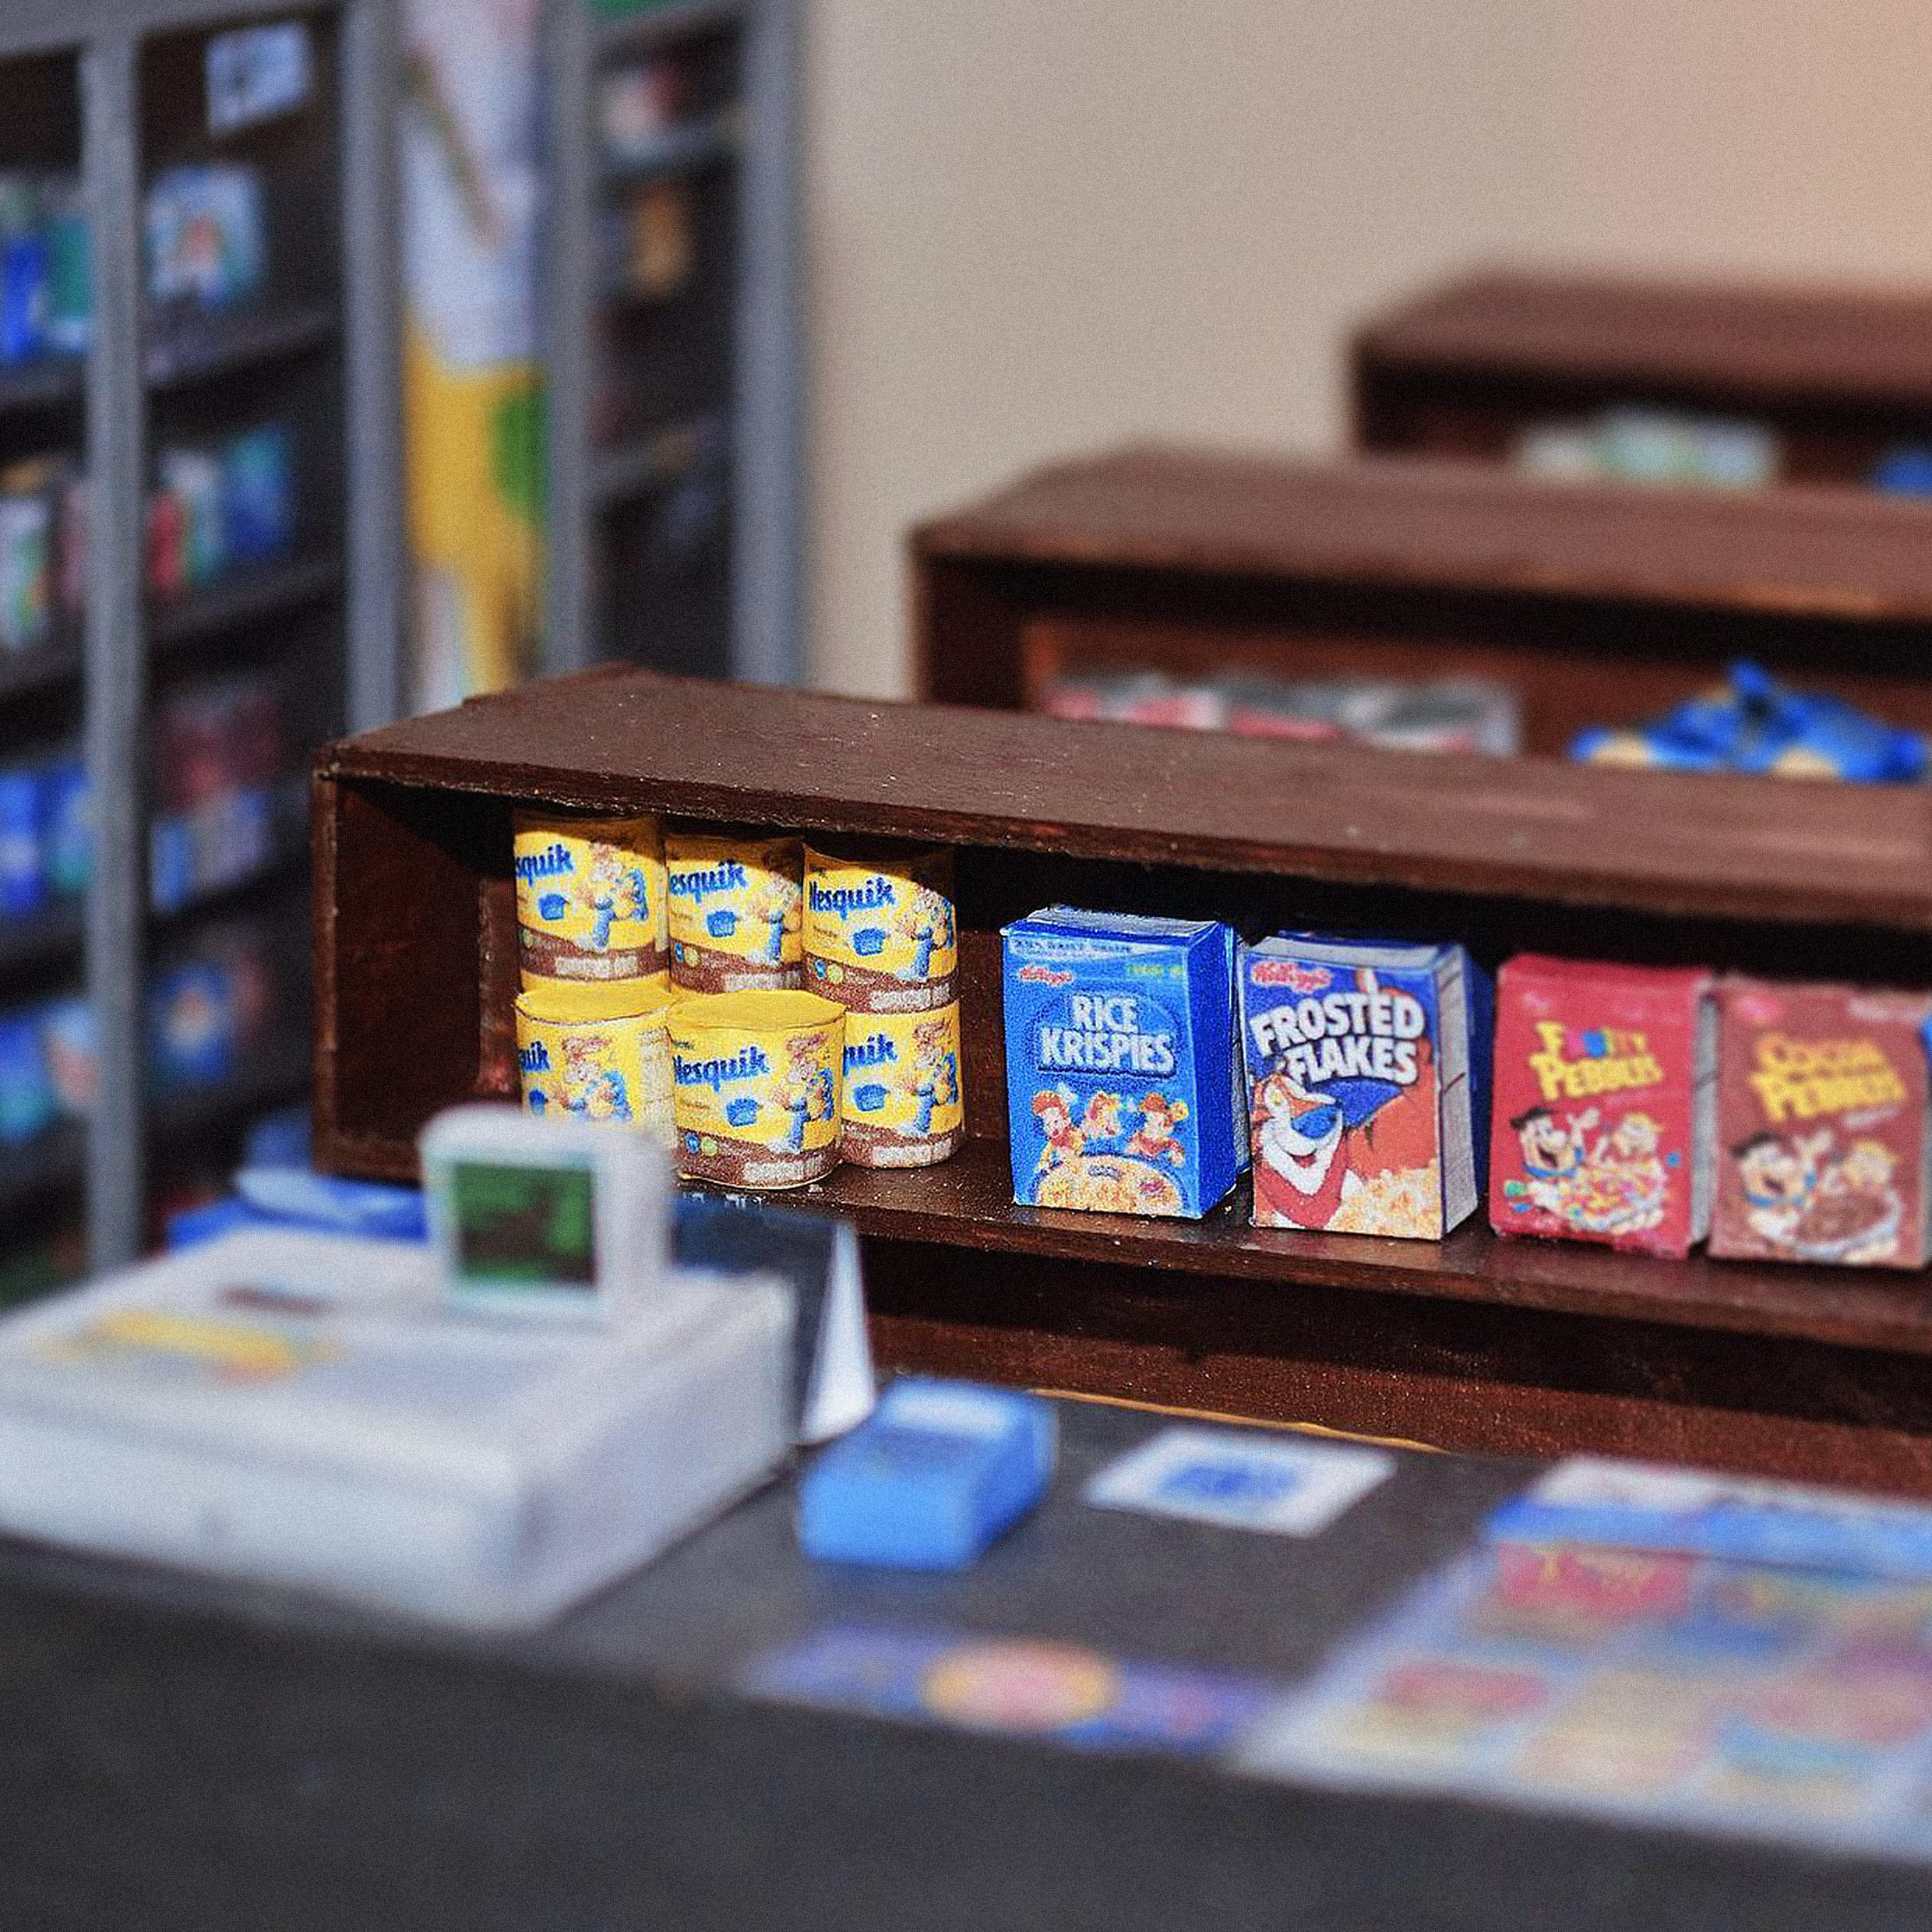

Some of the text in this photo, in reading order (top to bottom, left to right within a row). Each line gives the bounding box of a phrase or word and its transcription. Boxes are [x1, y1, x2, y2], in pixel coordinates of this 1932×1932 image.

[1071, 994, 1139, 1034] RICE
[1250, 992, 1426, 1057] FROSTED
[1040, 1026, 1176, 1074] KRISPIES
[1282, 1035, 1419, 1085] FLAKES
